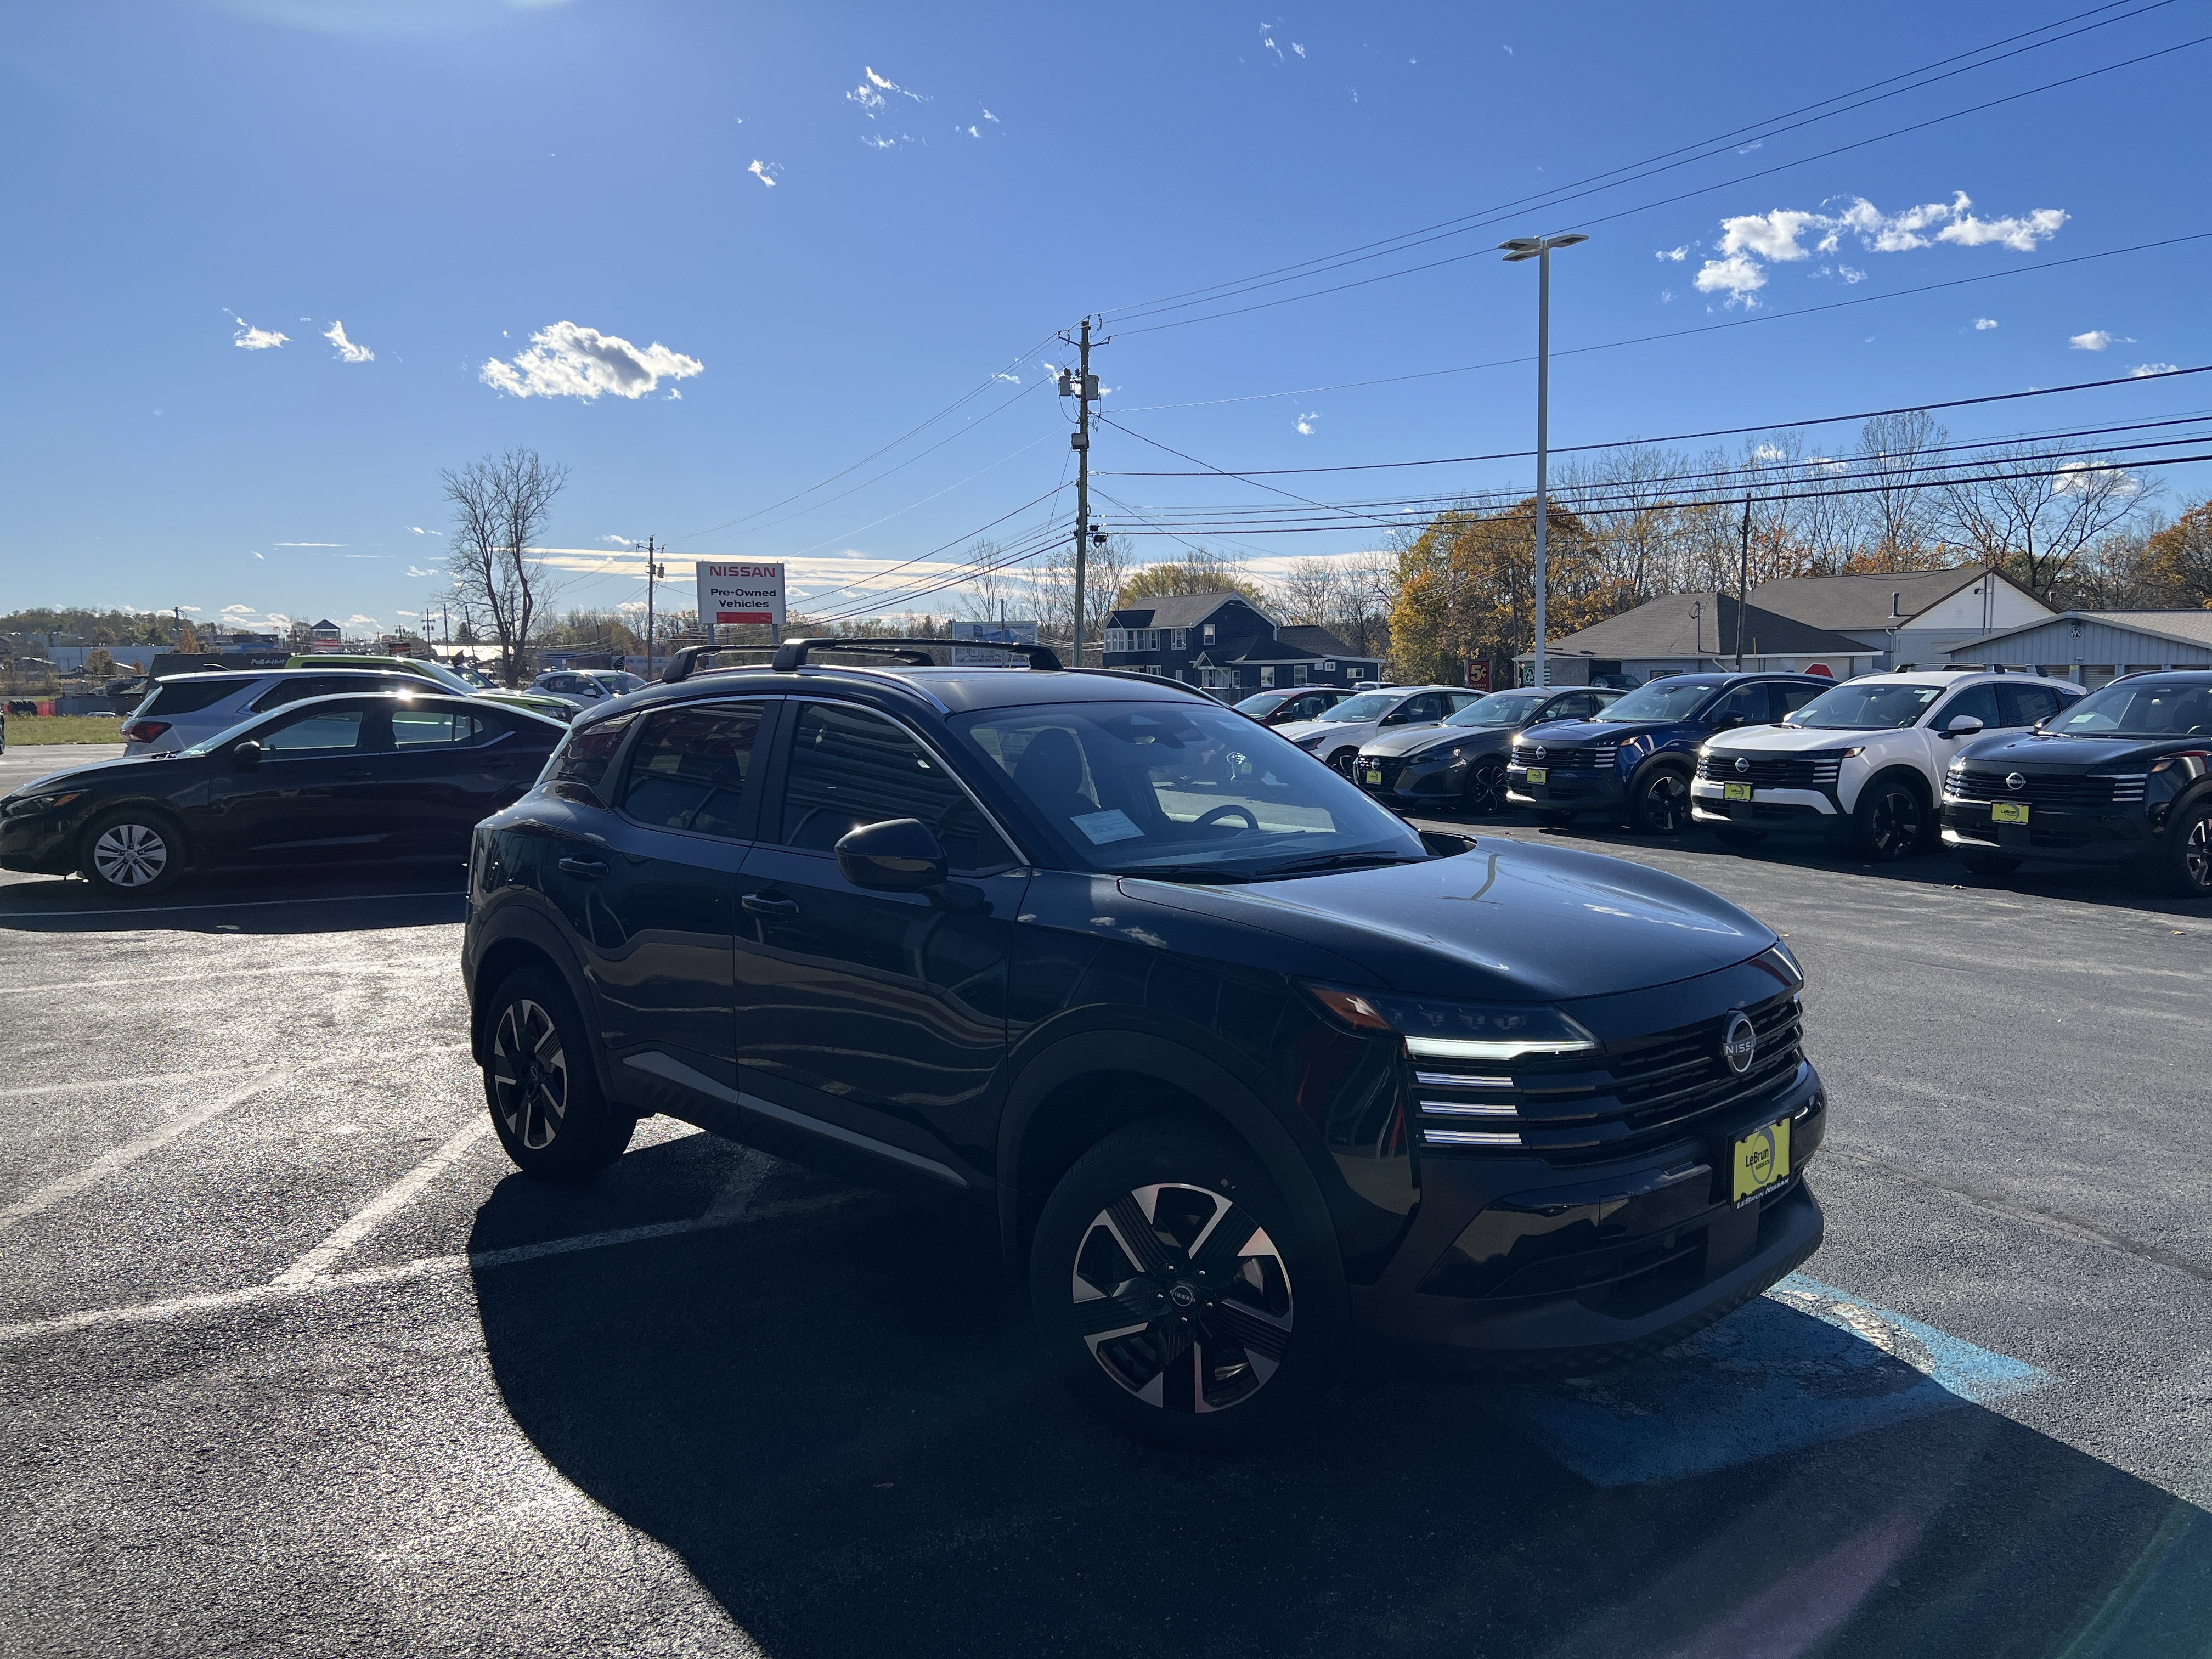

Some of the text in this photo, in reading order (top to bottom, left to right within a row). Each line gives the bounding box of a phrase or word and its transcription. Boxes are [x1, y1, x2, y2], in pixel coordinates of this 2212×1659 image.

[710, 566, 776, 577] NISSAN
[710, 588, 776, 596] Pre-Owned
[1471, 664, 1487, 682] 5¢
[1725, 1041, 1756, 1054] NISS
[1746, 1148, 1769, 1168] LeBrun
[1756, 1159, 1770, 1170] NISSAN
[1170, 1290, 1196, 1302] NISSAN
